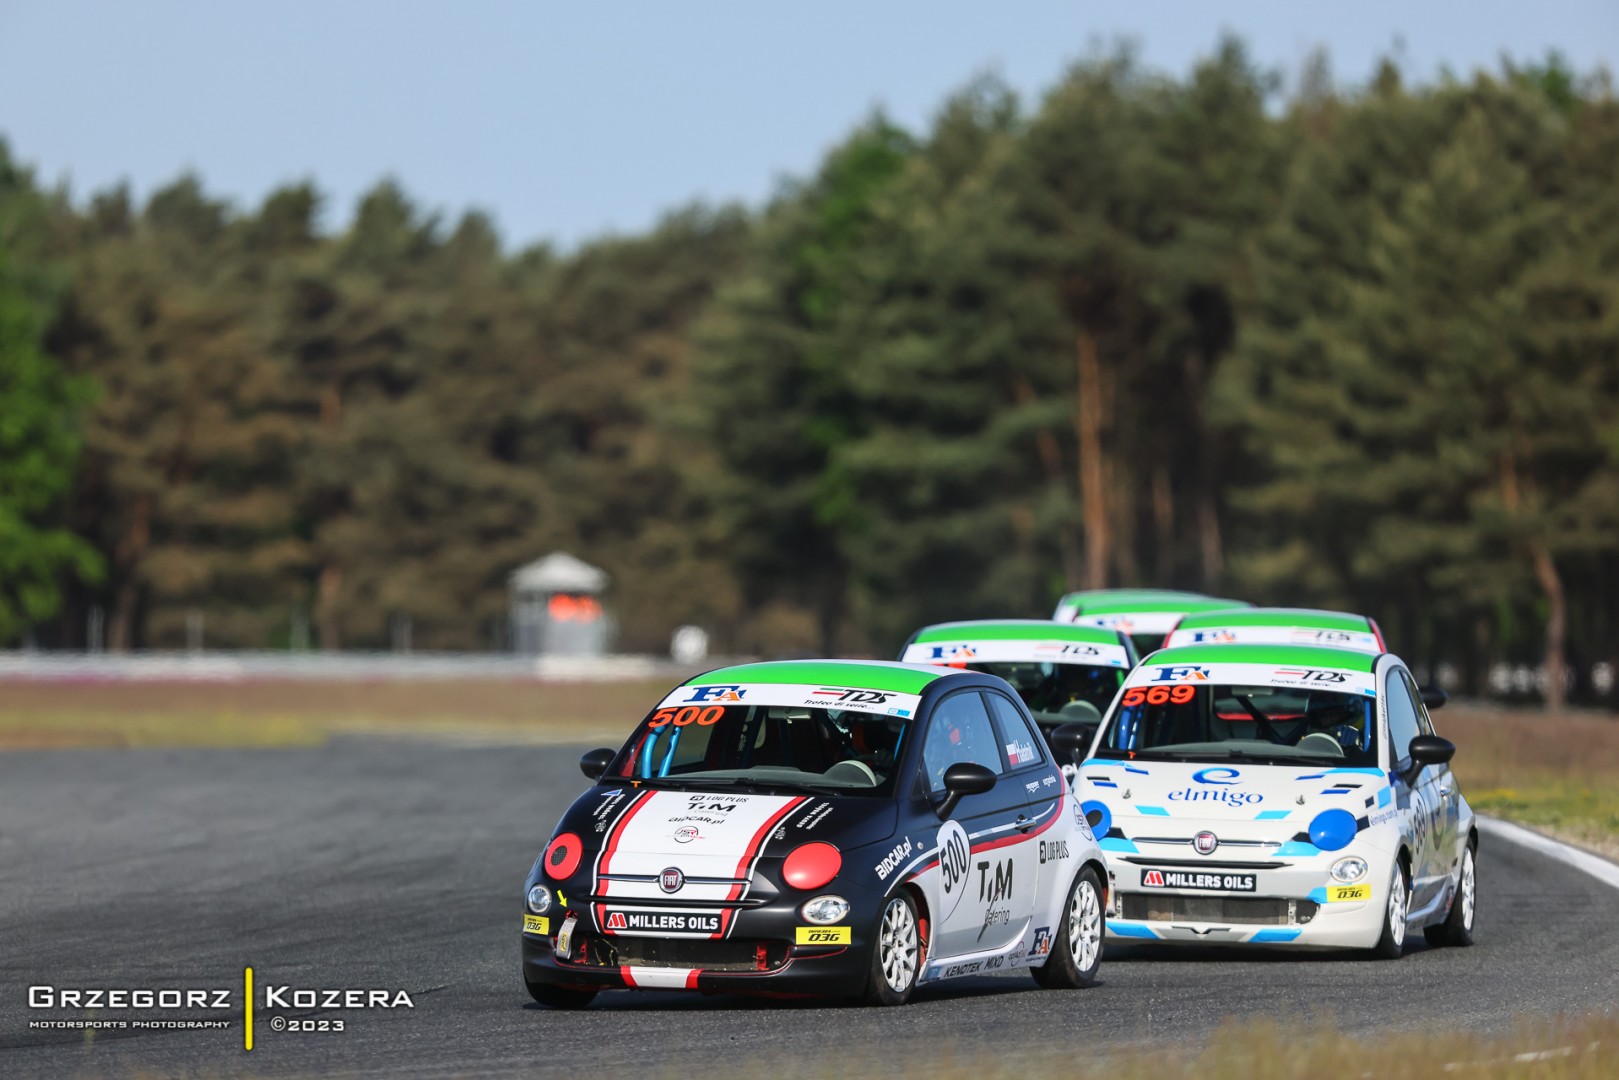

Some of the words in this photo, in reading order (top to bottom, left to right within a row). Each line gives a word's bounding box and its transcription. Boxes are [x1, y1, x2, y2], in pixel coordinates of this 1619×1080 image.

[1303, 669, 1353, 683] TDS
[838, 689, 898, 704] TDS
[1122, 684, 1195, 707] 569
[648, 705, 725, 728] 500
[1167, 788, 1264, 807] elmigo
[874, 836, 913, 880] BIDCAR.pl
[1047, 842, 1055, 861] LOG
[1055, 840, 1069, 859] PLUS
[940, 829, 967, 894] 500
[664, 875, 678, 886] FIAT
[1166, 873, 1221, 888] MILLERS
[1223, 875, 1253, 889] OILS
[629, 914, 685, 929] MILLERS
[688, 916, 719, 930] OILS
[944, 961, 983, 977] KENOTEK
